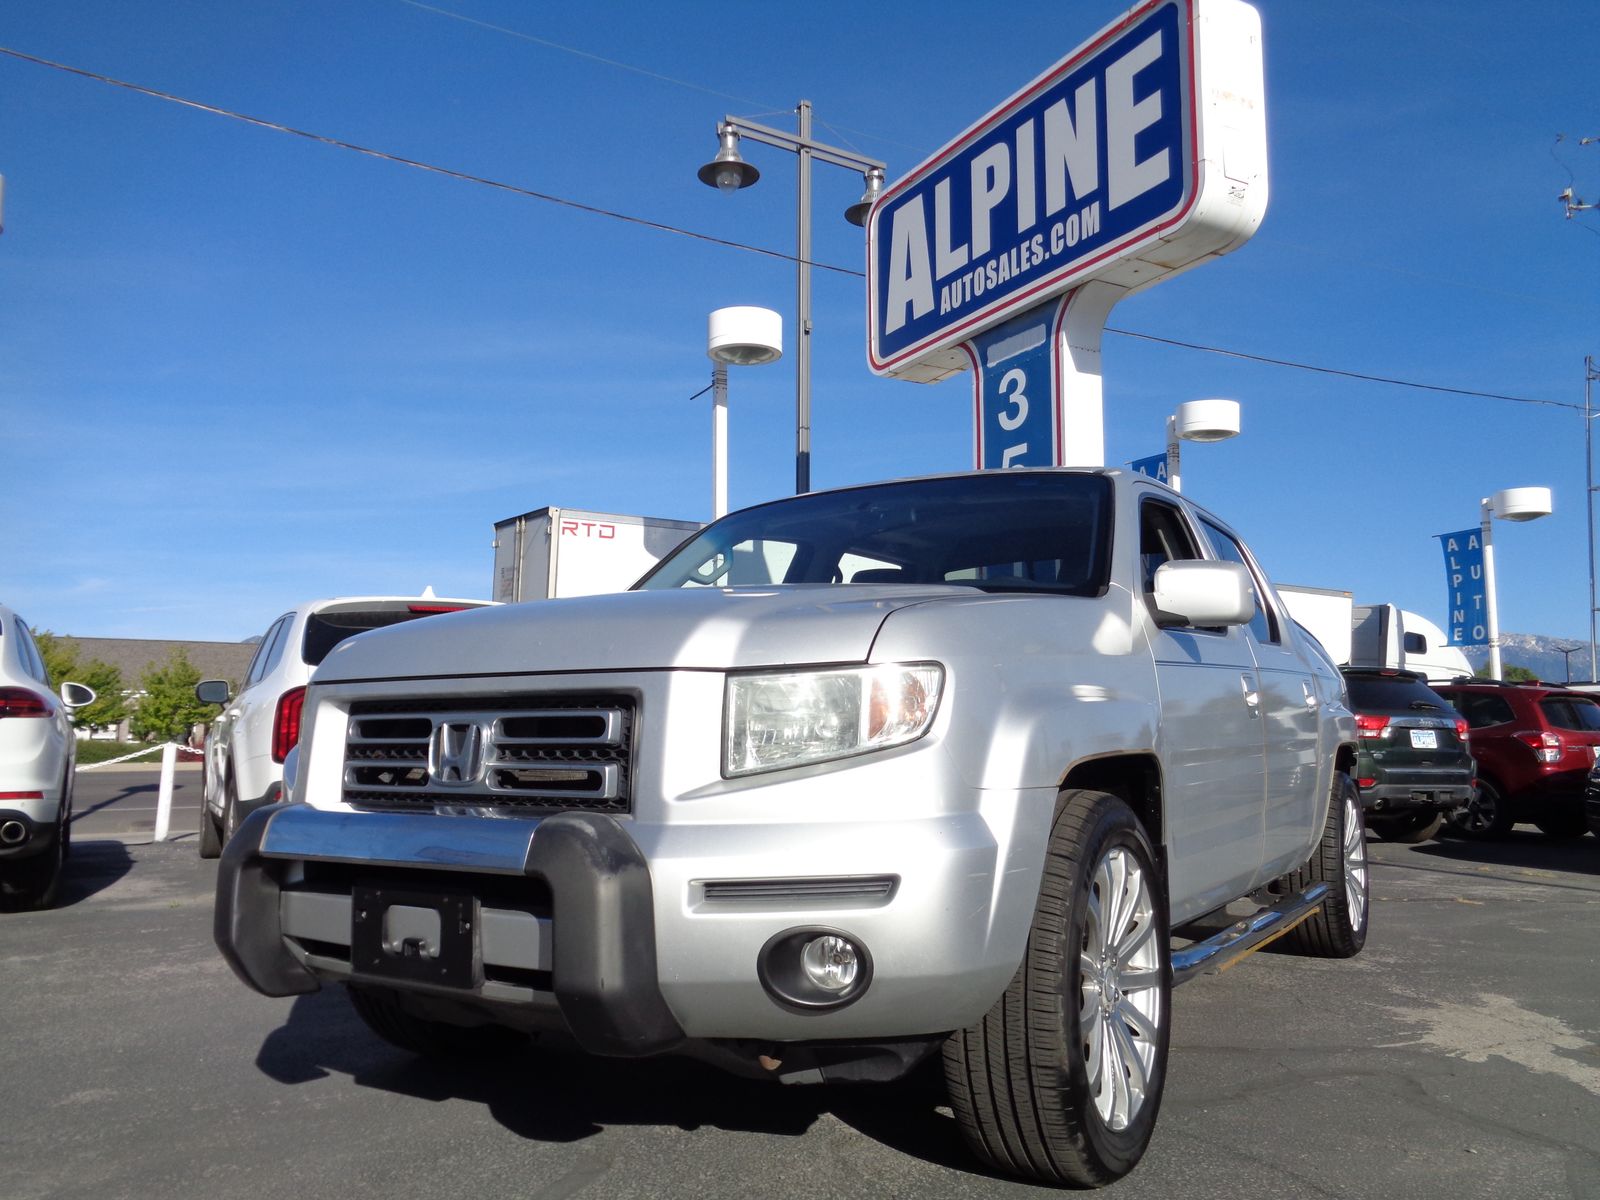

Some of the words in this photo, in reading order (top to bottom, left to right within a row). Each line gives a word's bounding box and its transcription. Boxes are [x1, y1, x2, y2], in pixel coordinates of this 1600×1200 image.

[885, 30, 1170, 336] ALPINE
[940, 201, 1100, 316] AUTOSALES.COM
[561, 521, 615, 539] RTD
[1447, 538, 1464, 641] ALPINE
[1468, 535, 1485, 640] AUTO
